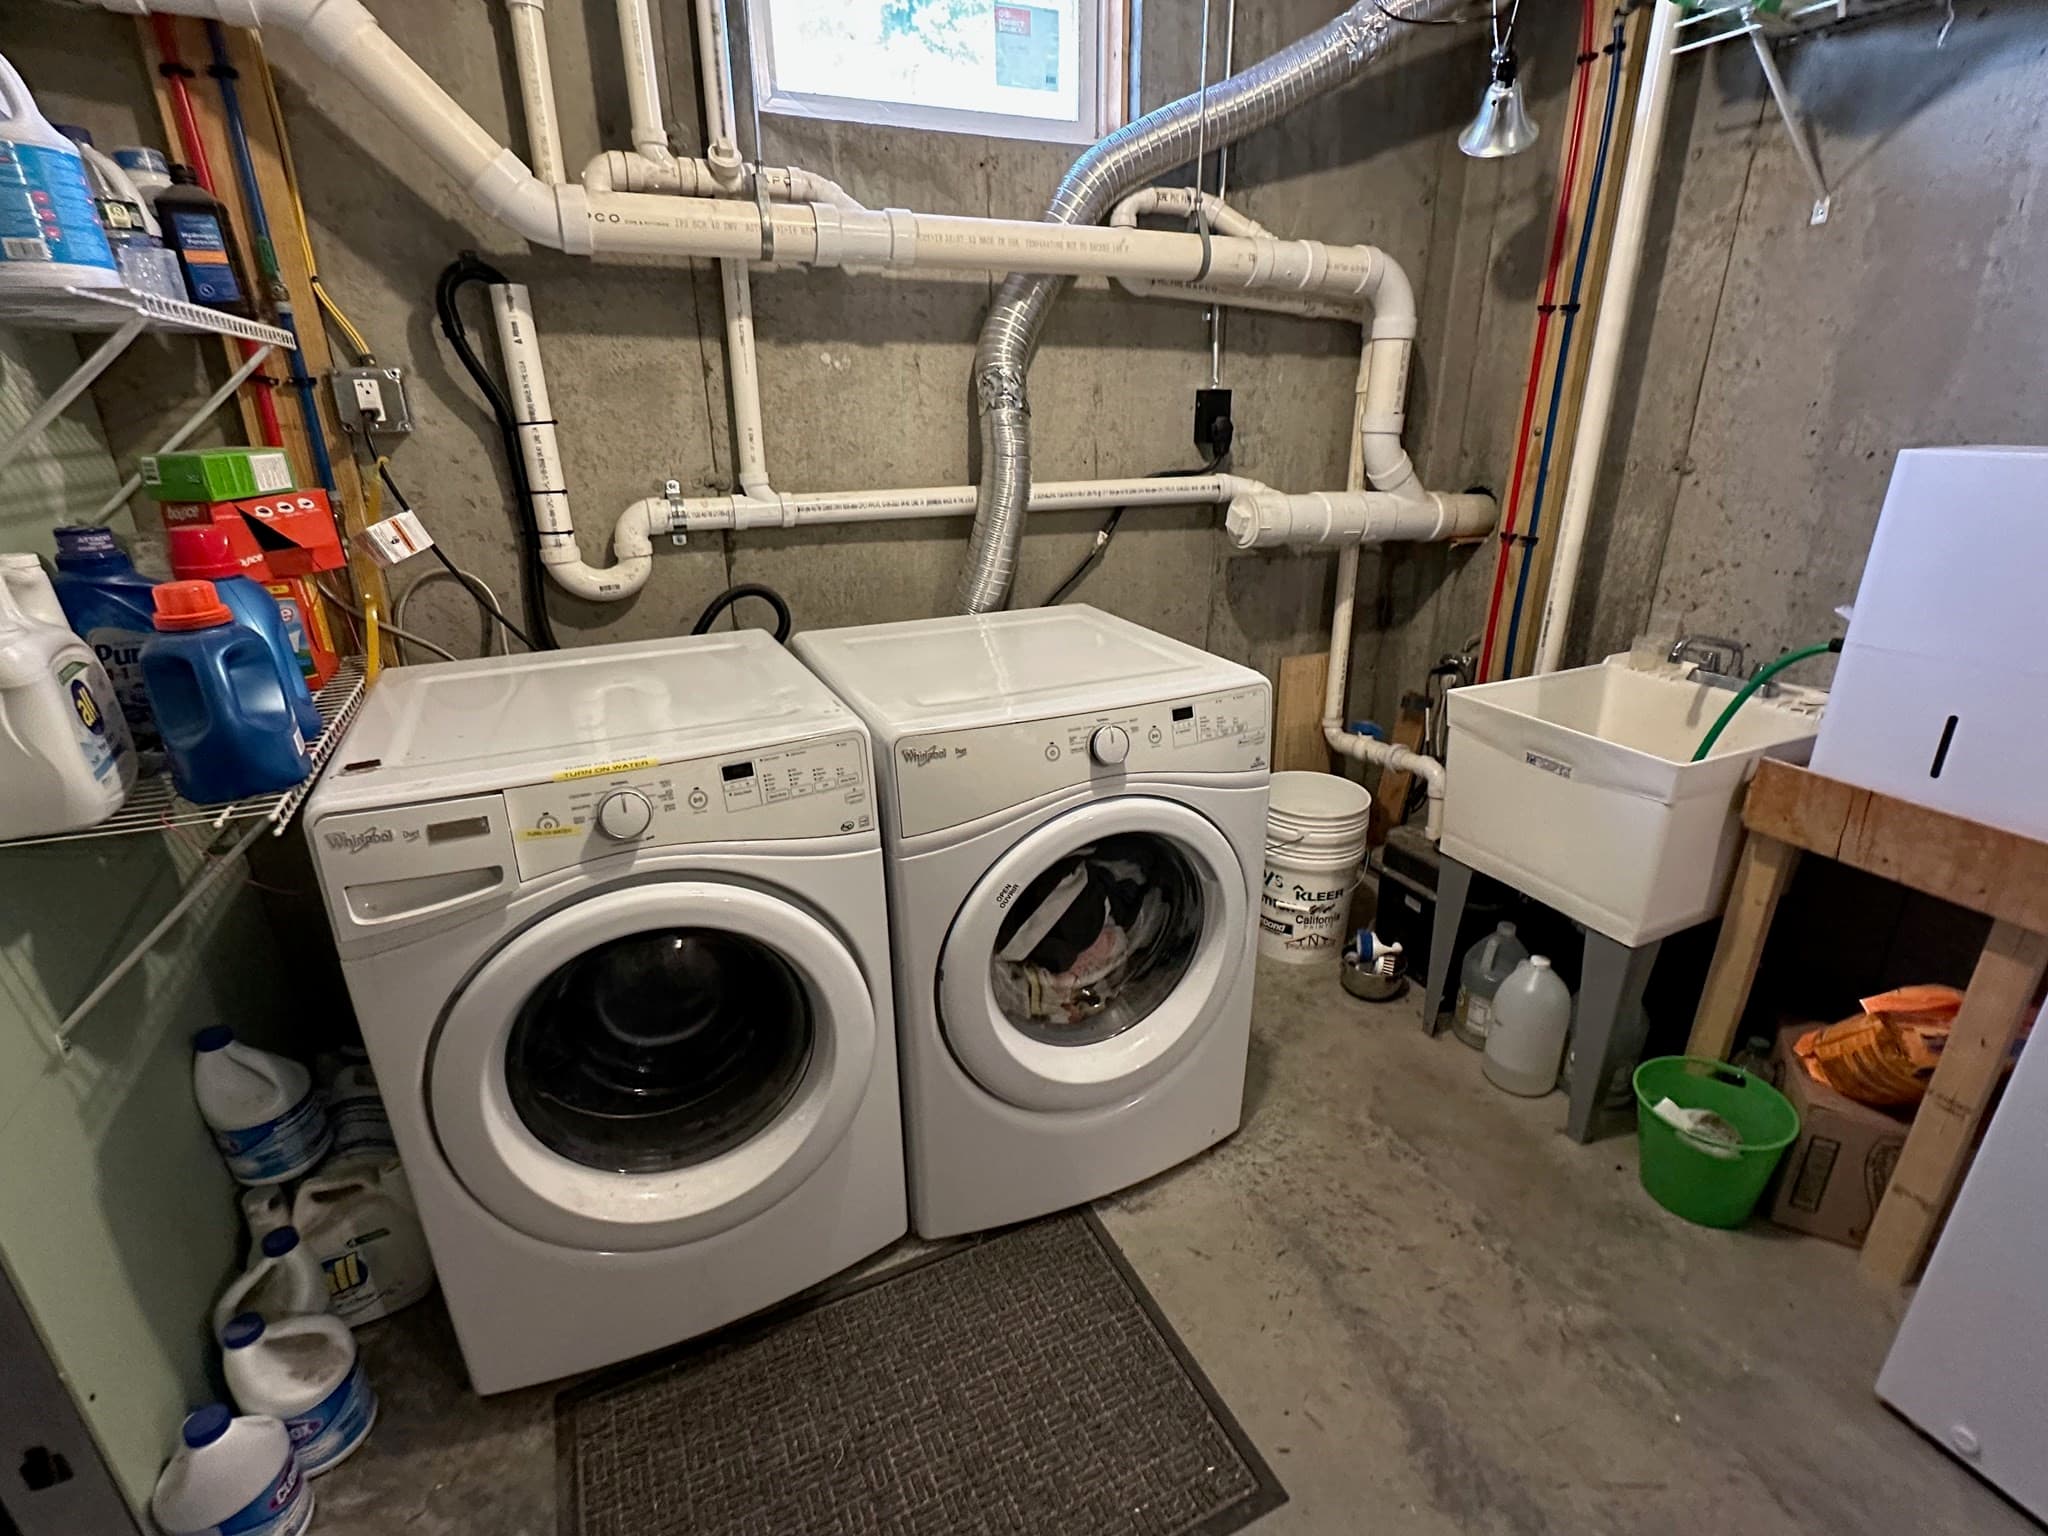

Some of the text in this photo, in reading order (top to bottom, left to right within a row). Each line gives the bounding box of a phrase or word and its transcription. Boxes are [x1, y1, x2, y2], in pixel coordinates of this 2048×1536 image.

[95, 644, 141, 665] Pur
[77, 686, 98, 727] all
[902, 745, 947, 767] Whirlpool
[565, 769, 593, 778] TURN
[613, 760, 649, 770] WATER
[324, 827, 394, 855] Whirlpool
[996, 883, 1012, 902] OPEN
[1295, 913, 1341, 925] California
